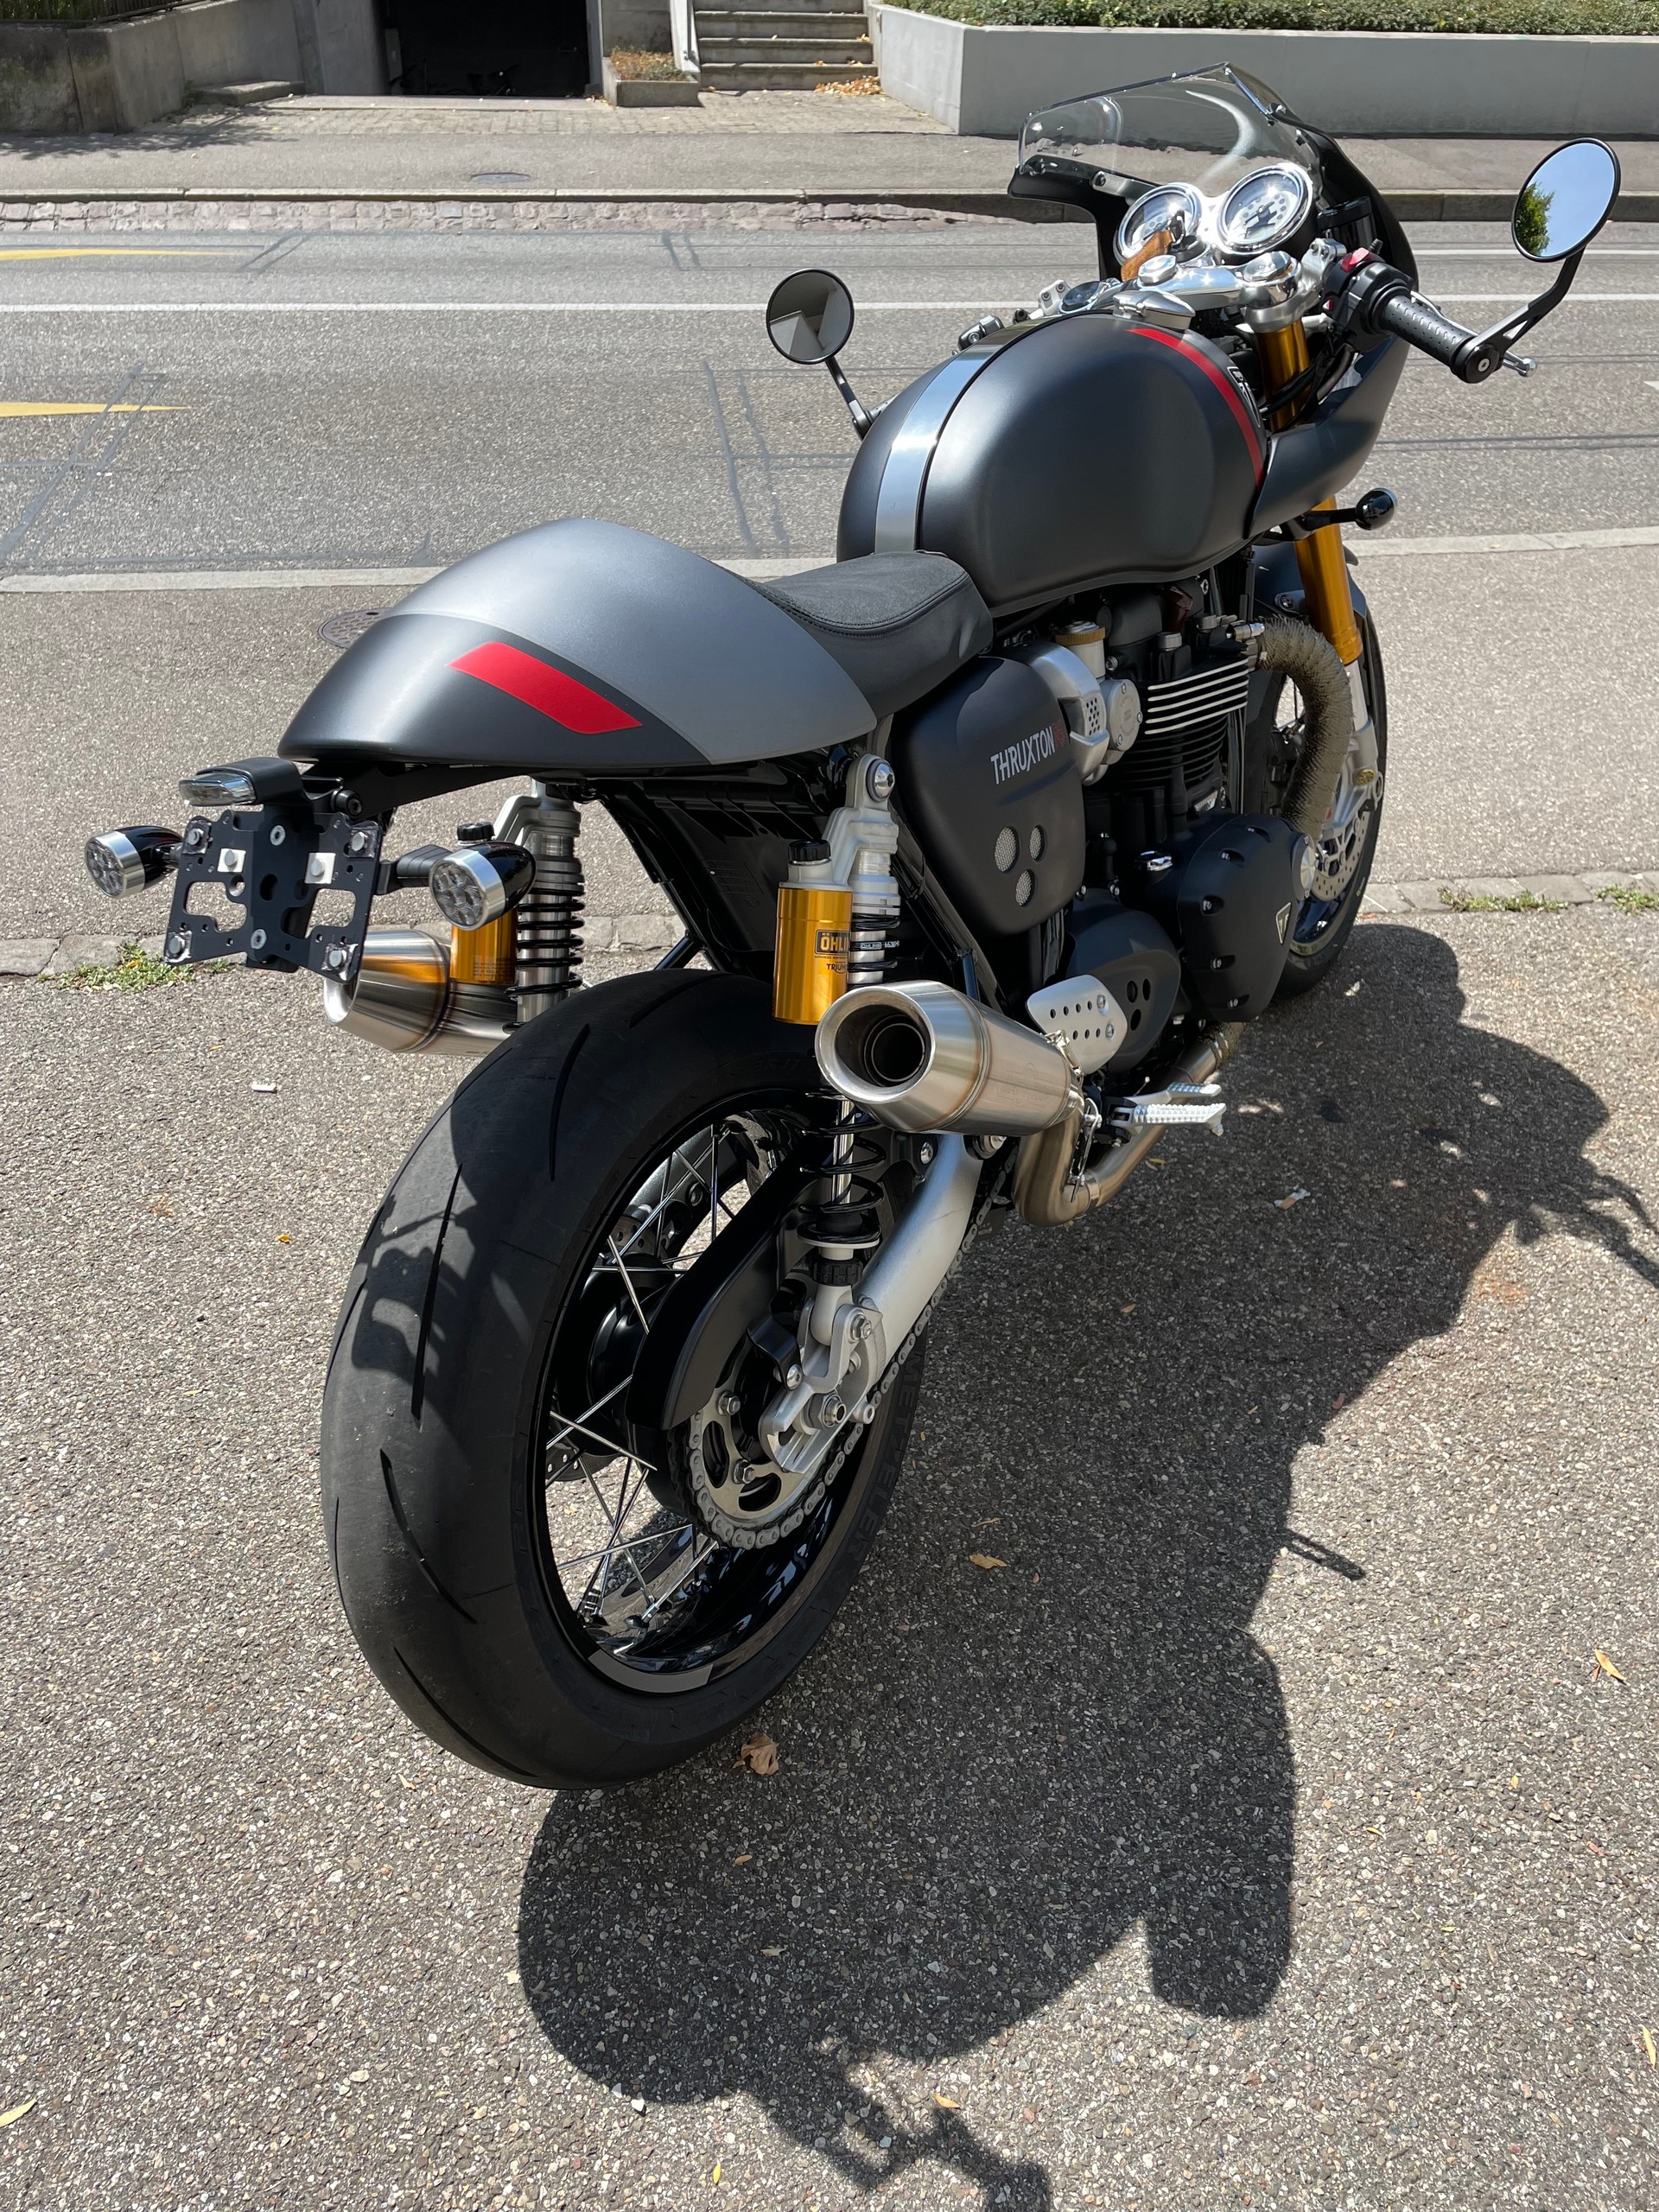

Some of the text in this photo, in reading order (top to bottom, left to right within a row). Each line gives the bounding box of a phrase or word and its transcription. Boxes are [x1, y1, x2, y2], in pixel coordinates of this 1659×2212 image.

[990, 726, 1055, 785] THRUXTON
[820, 932, 847, 951] ÖHLI
[826, 963, 847, 974] TRIUM
[848, 1351, 923, 1562] METZELER
